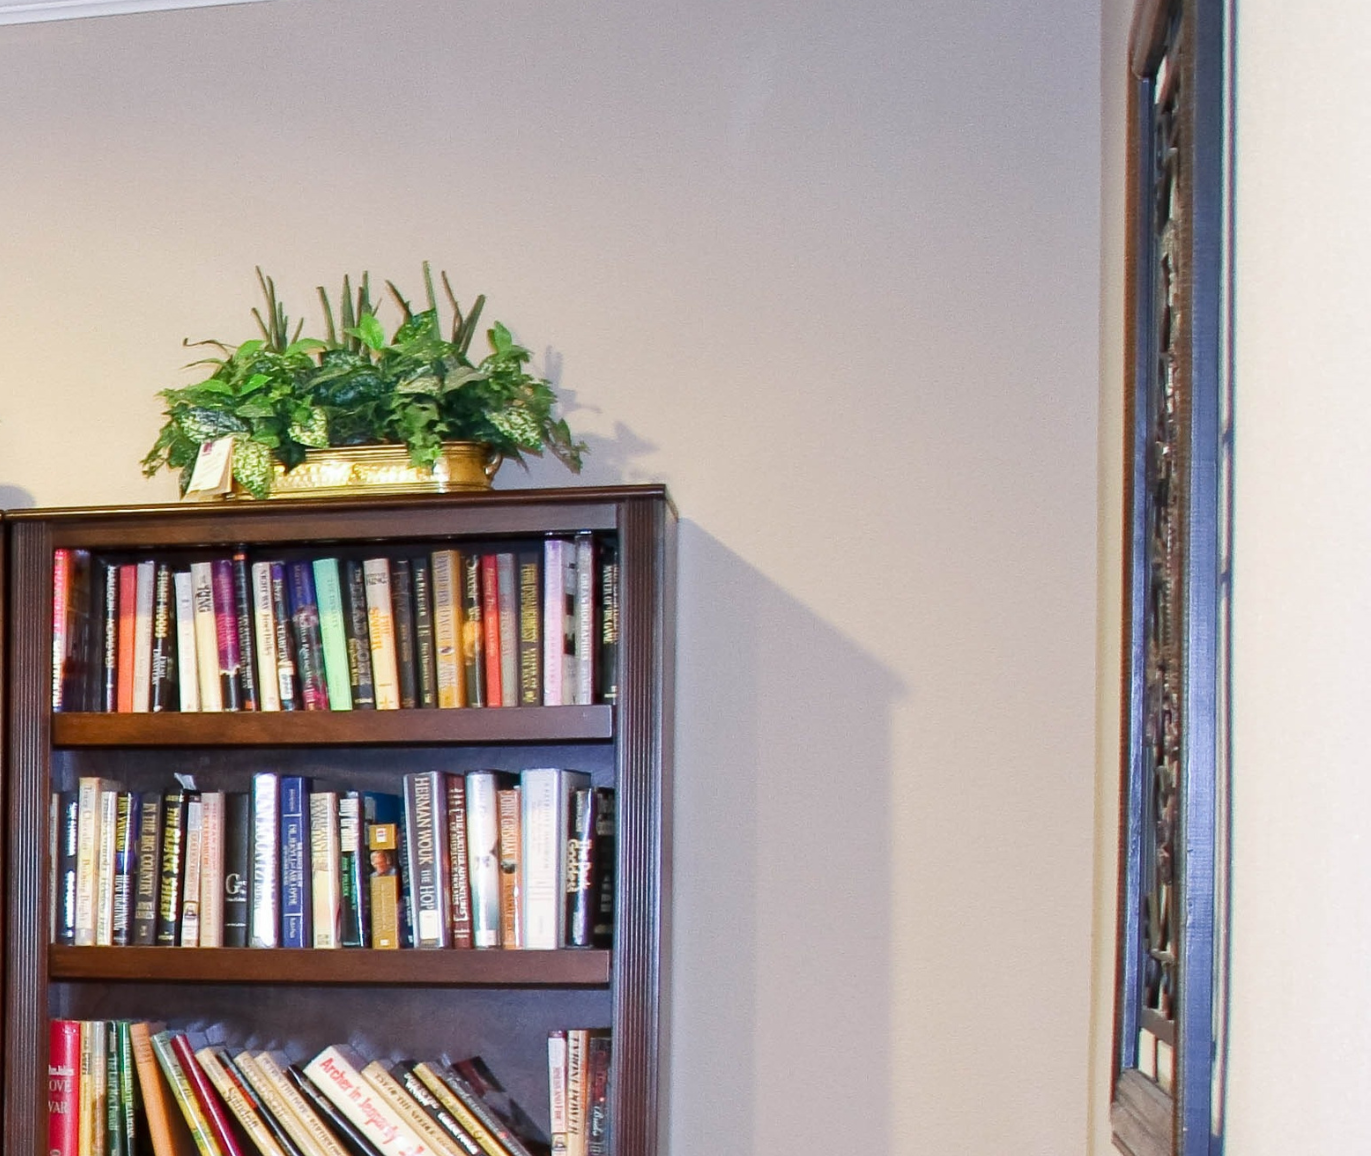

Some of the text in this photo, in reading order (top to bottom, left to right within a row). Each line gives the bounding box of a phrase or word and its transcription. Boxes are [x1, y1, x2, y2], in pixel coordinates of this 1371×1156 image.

[155, 605, 167, 638] WOODS
[139, 803, 156, 897] IN THE BIG COUNTRY
[339, 799, 359, 851] Billy Graham
[414, 777, 434, 910] HERMAN WOUK THE HOP
[500, 793, 518, 855] JOHN GRISHAM
[49, 1079, 72, 1093] OVE
[318, 1058, 398, 1145] Archer in Jeopardy
[569, 1038, 580, 1134] TYRONE POWER
